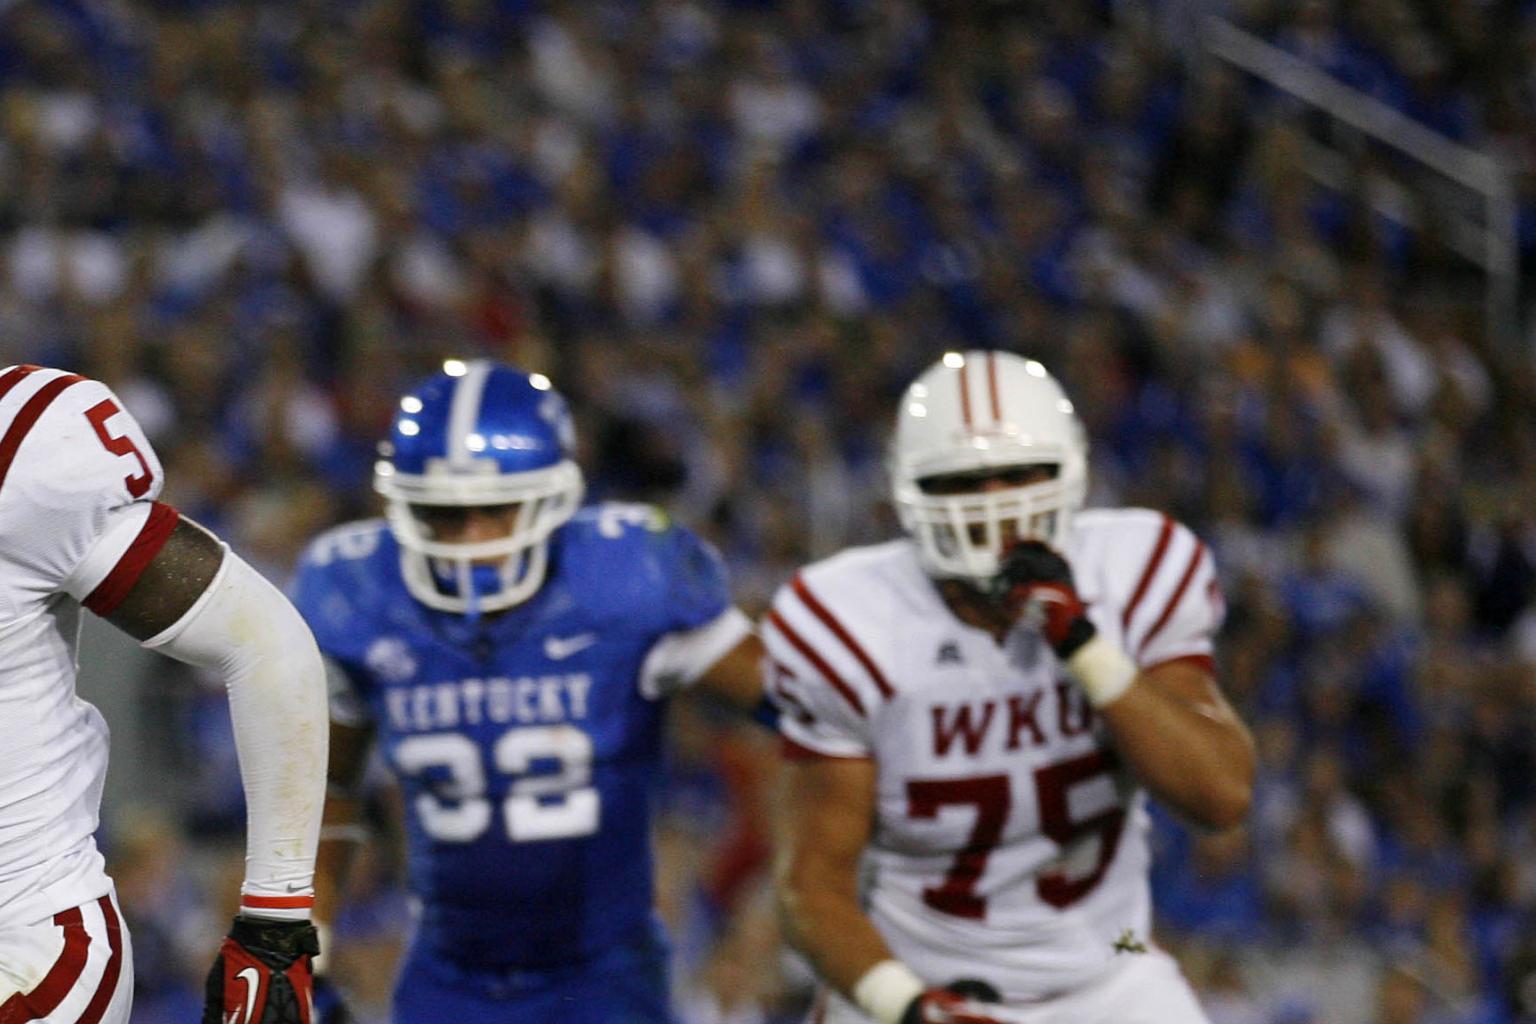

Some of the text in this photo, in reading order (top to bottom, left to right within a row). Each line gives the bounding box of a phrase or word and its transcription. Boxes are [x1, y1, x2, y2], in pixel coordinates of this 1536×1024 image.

[84, 398, 154, 498] 5
[386, 674, 593, 730] KENTUCKY
[932, 683, 1091, 757] WKU
[394, 725, 601, 843] 32
[906, 750, 1128, 921] 75
